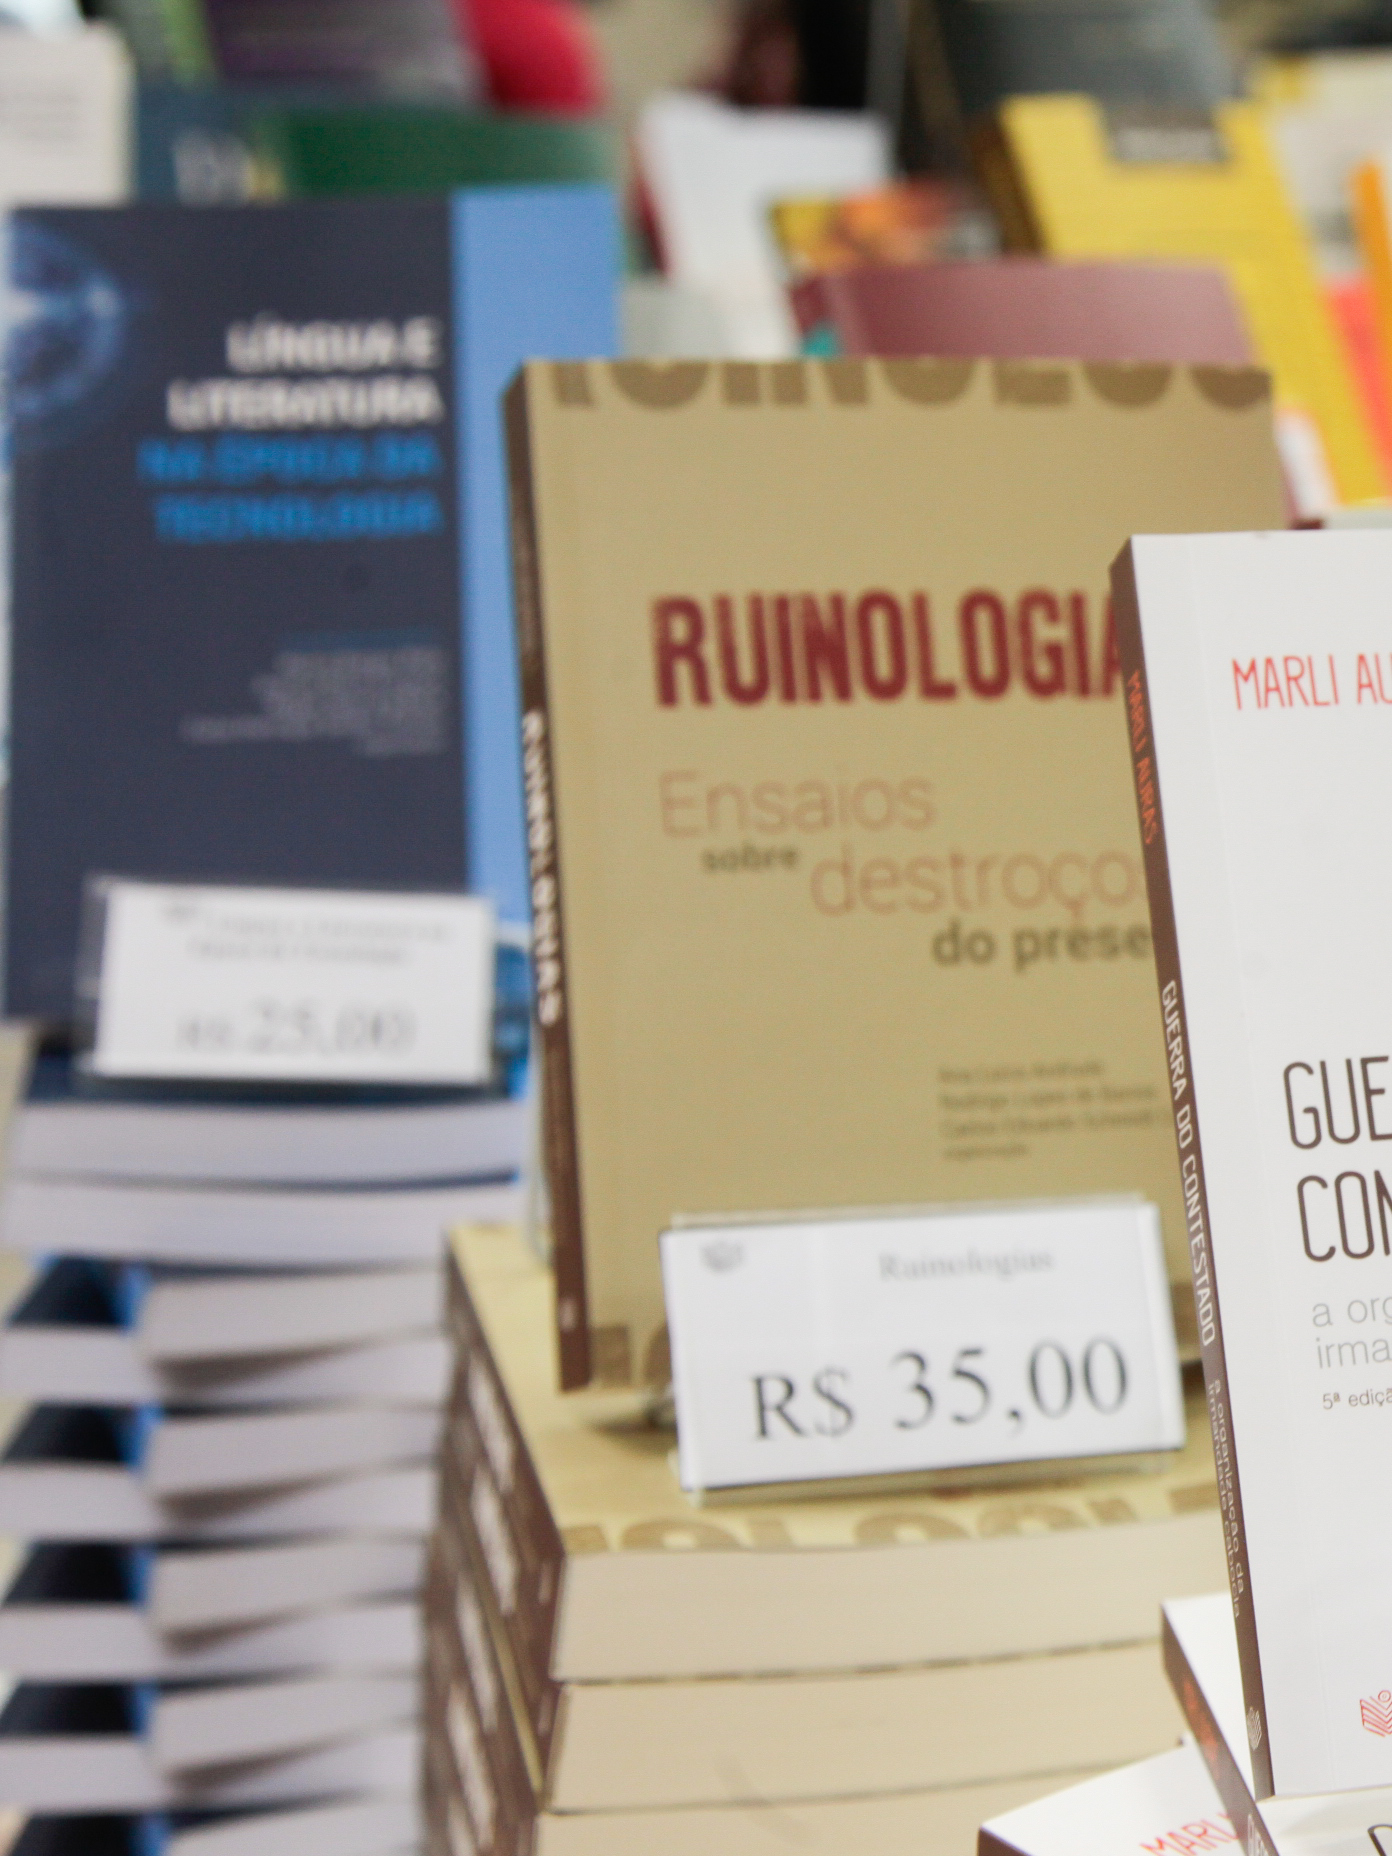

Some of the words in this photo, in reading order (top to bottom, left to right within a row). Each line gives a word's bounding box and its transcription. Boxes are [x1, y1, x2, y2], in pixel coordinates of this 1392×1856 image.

[654, 588, 1122, 707] RUINOLOGIA
[1232, 655, 1339, 711] MARLI
[658, 768, 937, 838] Ensaios
[702, 845, 798, 873] sobre
[809, 843, 1146, 926] destroço
[931, 918, 996, 967] do
[1014, 924, 1154, 974] prese
[1162, 980, 1187, 1100] GUERRA
[1176, 1104, 1193, 1149] DO
[1182, 1154, 1216, 1346] CONTESTADO
[1312, 1302, 1333, 1328] a
[752, 1364, 855, 1440] R$
[894, 1335, 1129, 1437] 35,00
[1139, 1812, 1239, 1856] MARL
